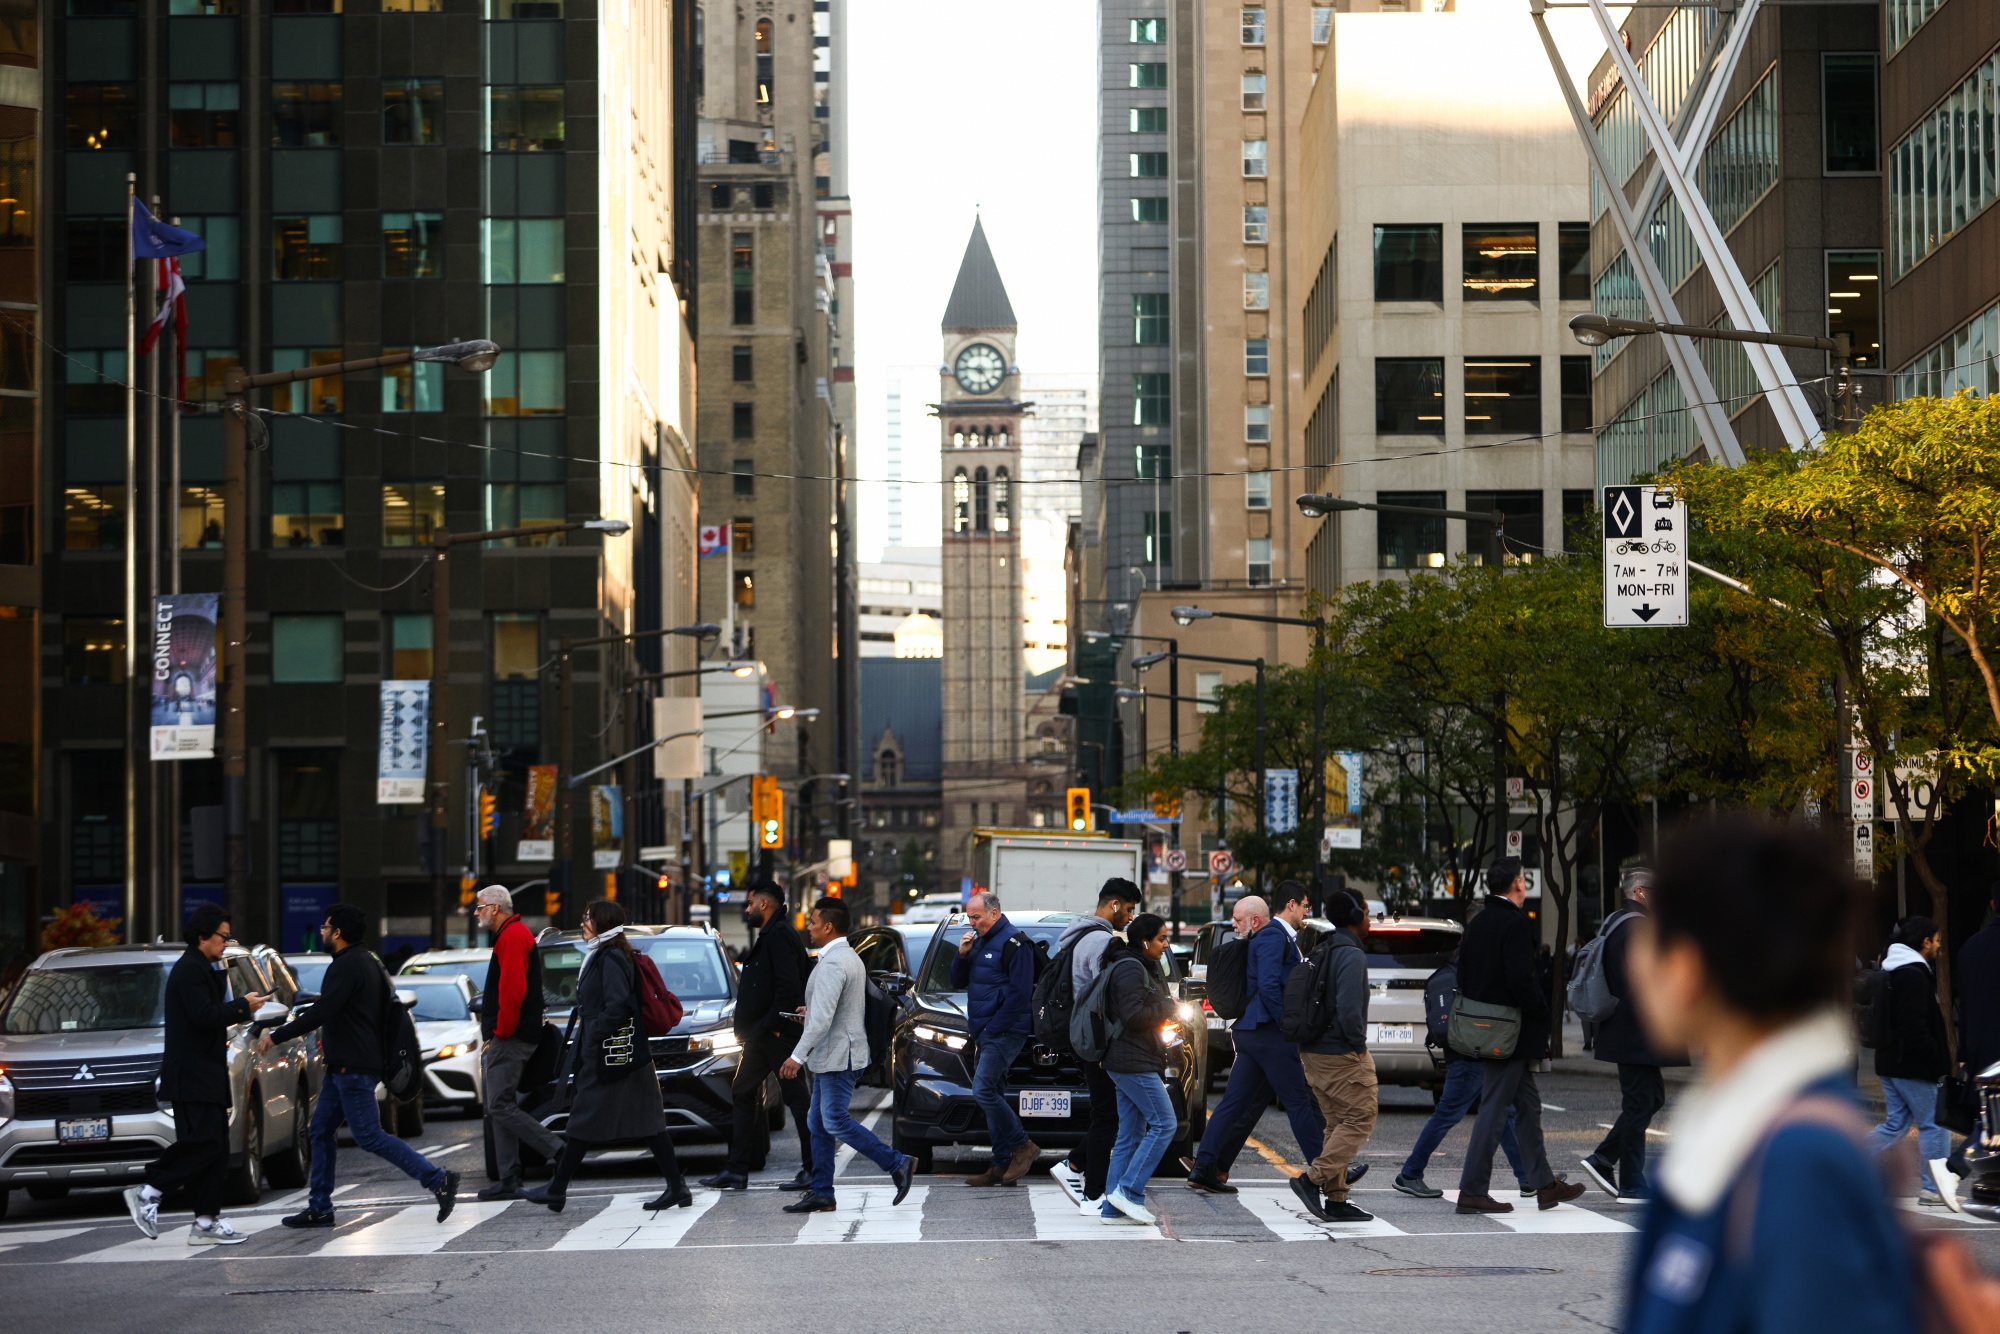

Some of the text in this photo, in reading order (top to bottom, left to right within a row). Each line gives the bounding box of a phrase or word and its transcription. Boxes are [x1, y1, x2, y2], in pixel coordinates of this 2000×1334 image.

[1618, 583, 1674, 596] MON-FRI
[155, 602, 173, 681] CONNECT
[382, 685, 395, 773] OPPORTUNITY
[1352, 756, 1360, 806] DISCOVER
[1889, 780, 1935, 809] 40
